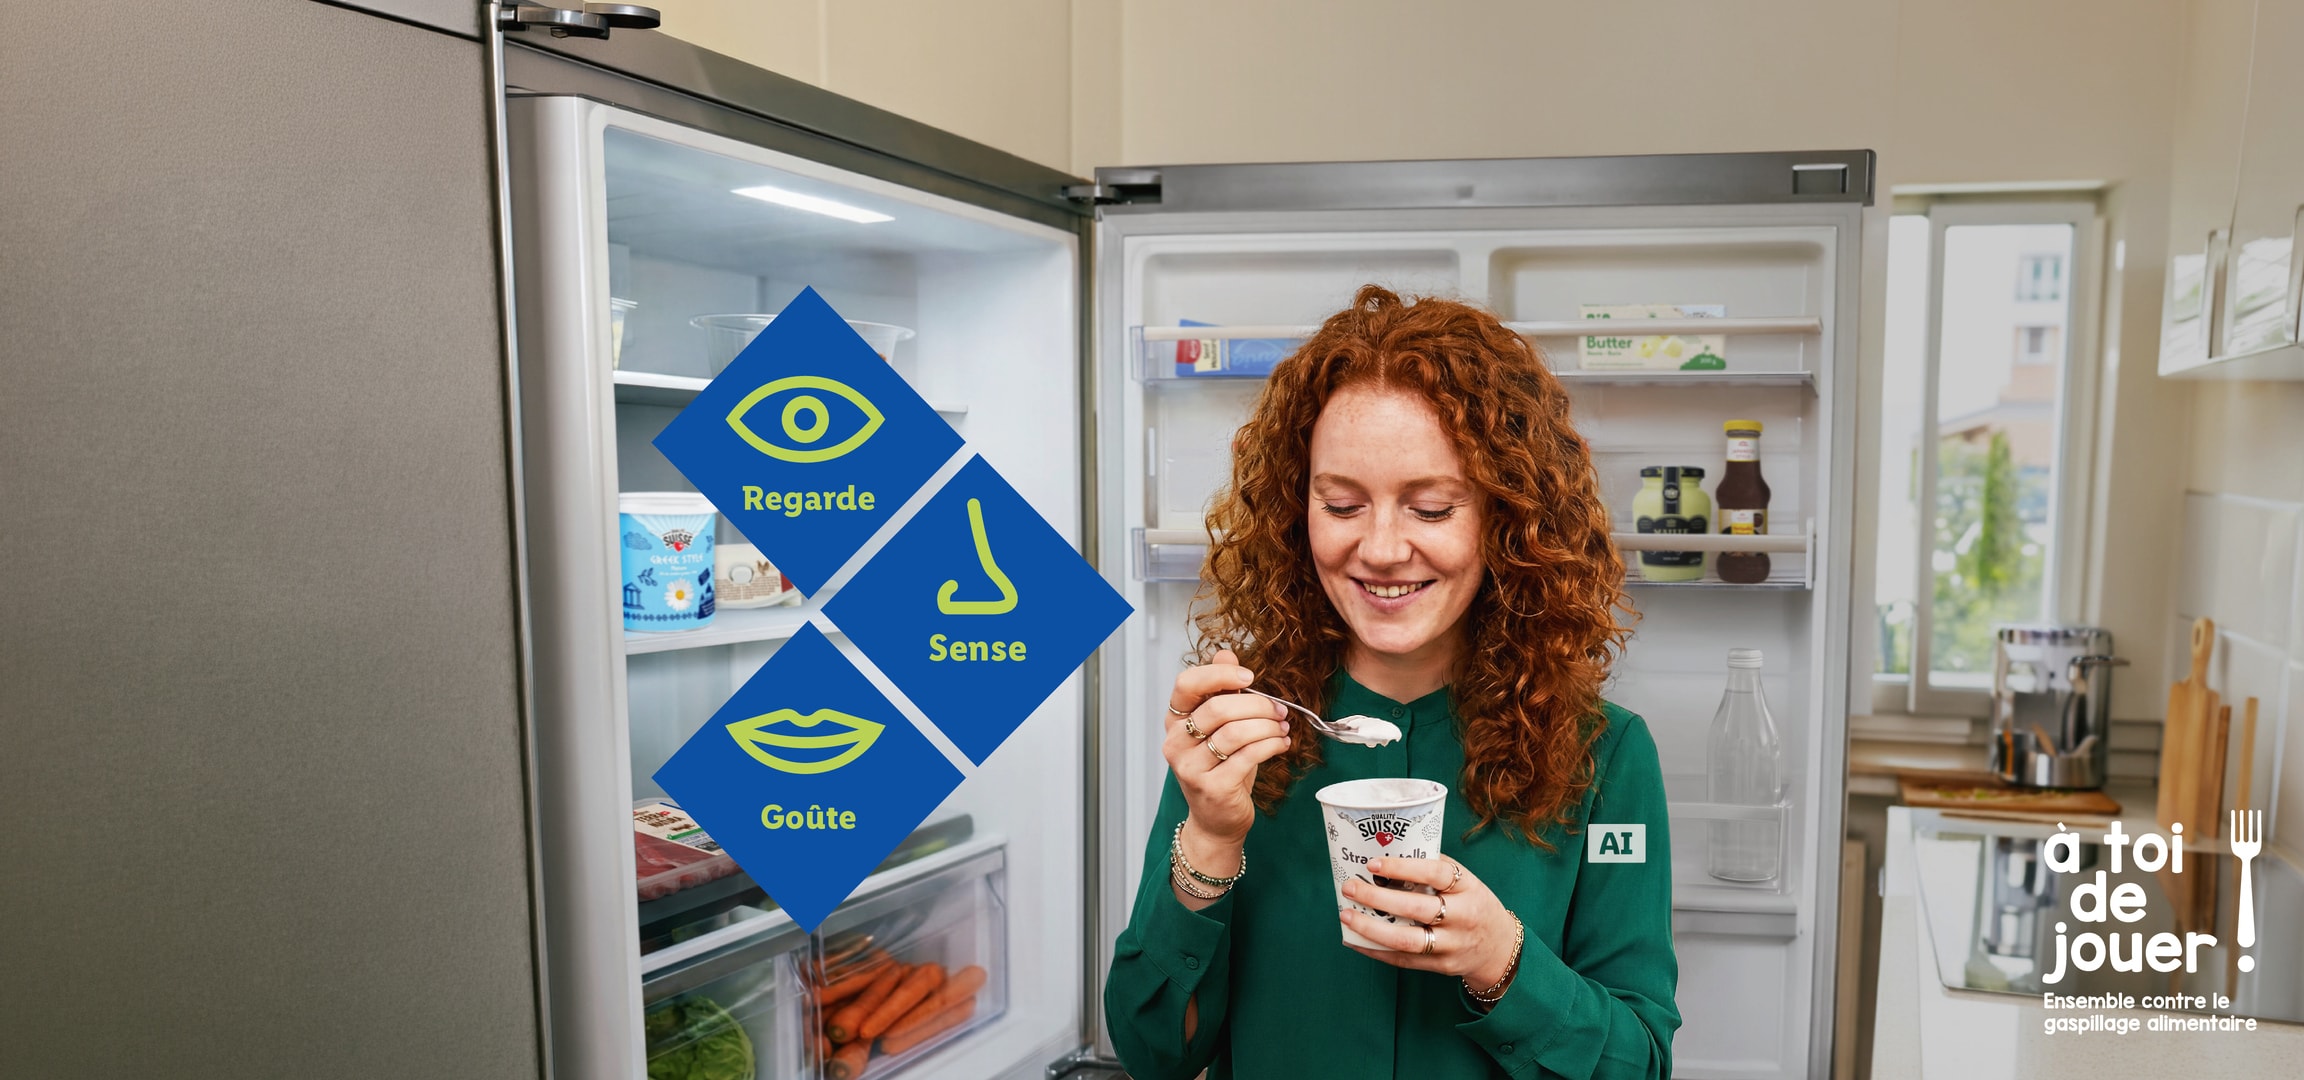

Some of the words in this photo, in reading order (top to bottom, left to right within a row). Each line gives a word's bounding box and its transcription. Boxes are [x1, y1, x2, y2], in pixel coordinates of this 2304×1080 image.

[1586, 336, 1632, 349] Butter
[663, 533, 693, 547] SUISSE
[1371, 813, 1396, 821] QUALITÉ
[1358, 820, 1410, 838] SUISSE
